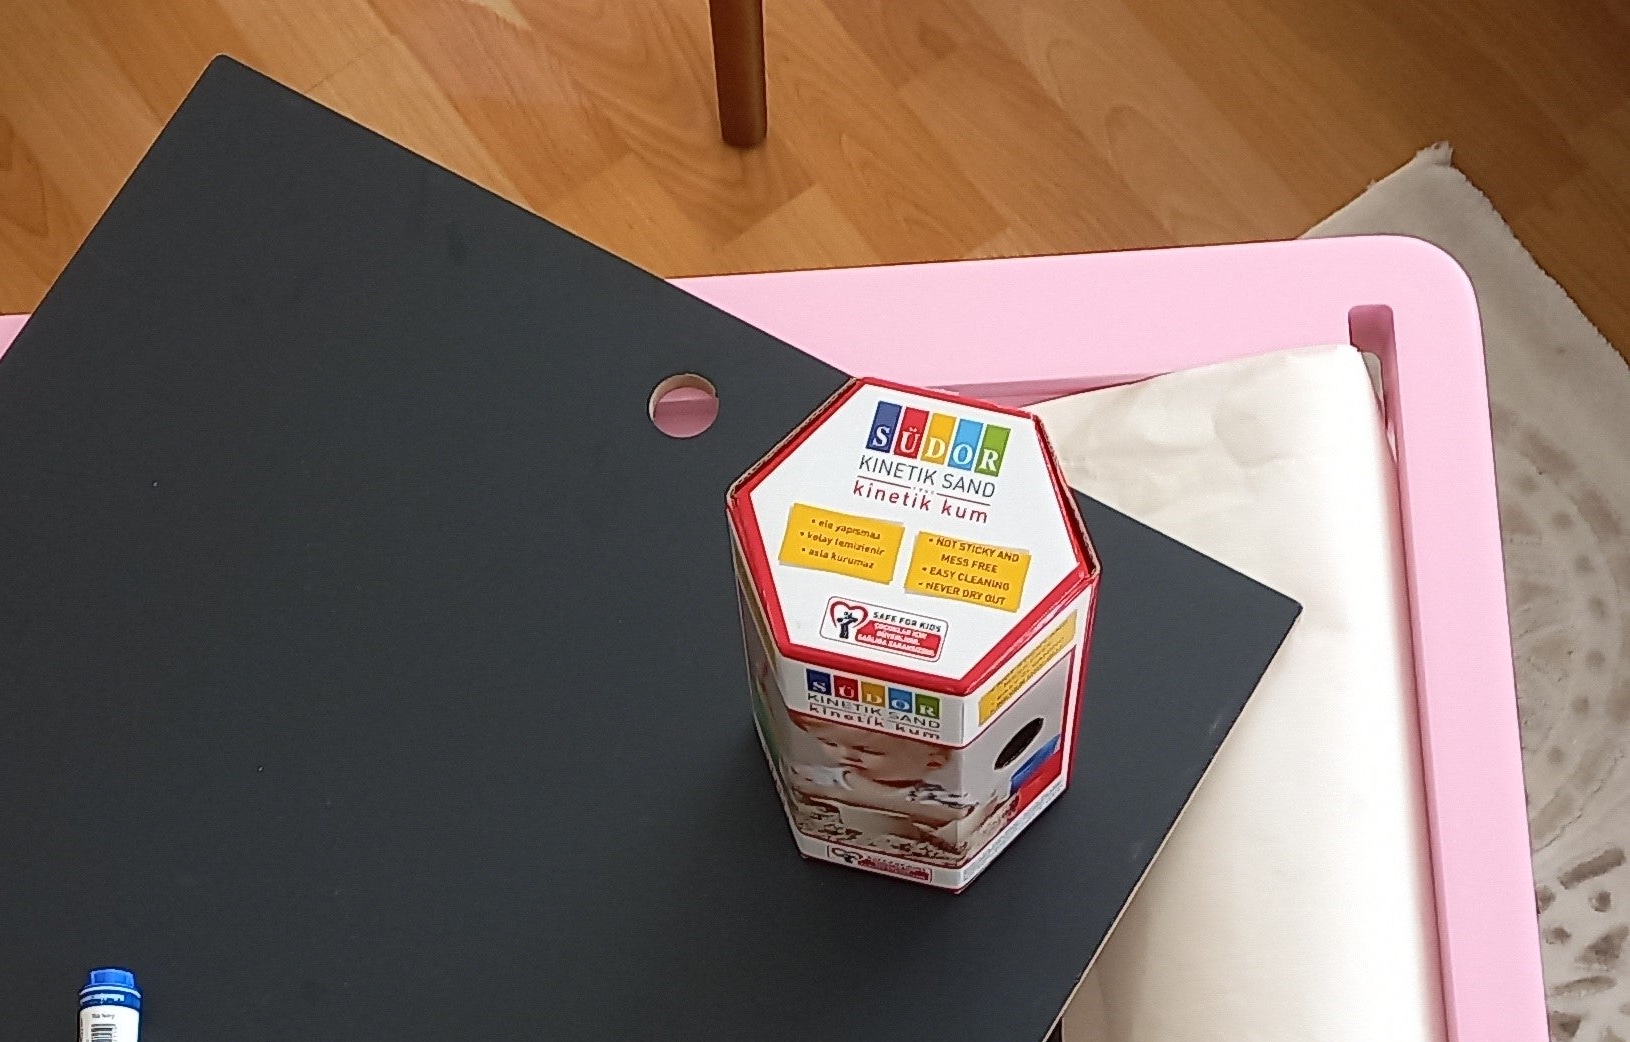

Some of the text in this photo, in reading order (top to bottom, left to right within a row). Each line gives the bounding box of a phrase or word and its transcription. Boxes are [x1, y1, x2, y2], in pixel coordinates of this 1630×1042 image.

[872, 425, 999, 472] SÜDOR
[858, 454, 937, 486] KINETIK
[941, 473, 996, 498] SAND
[853, 480, 932, 511] kinetik
[941, 498, 988, 523] kum
[936, 537, 1020, 562] NOT STICKY AND
[940, 553, 999, 573] MESS FREE
[925, 581, 1007, 605] NEVER DRY OUT
[929, 566, 1010, 591] EASY CLEANING
[873, 611, 898, 621] SAFE
[899, 617, 917, 627] FOR
[919, 622, 942, 632] KIDS
[807, 692, 941, 729] KINETIK SAND
[809, 702, 941, 740] kinetik kum
